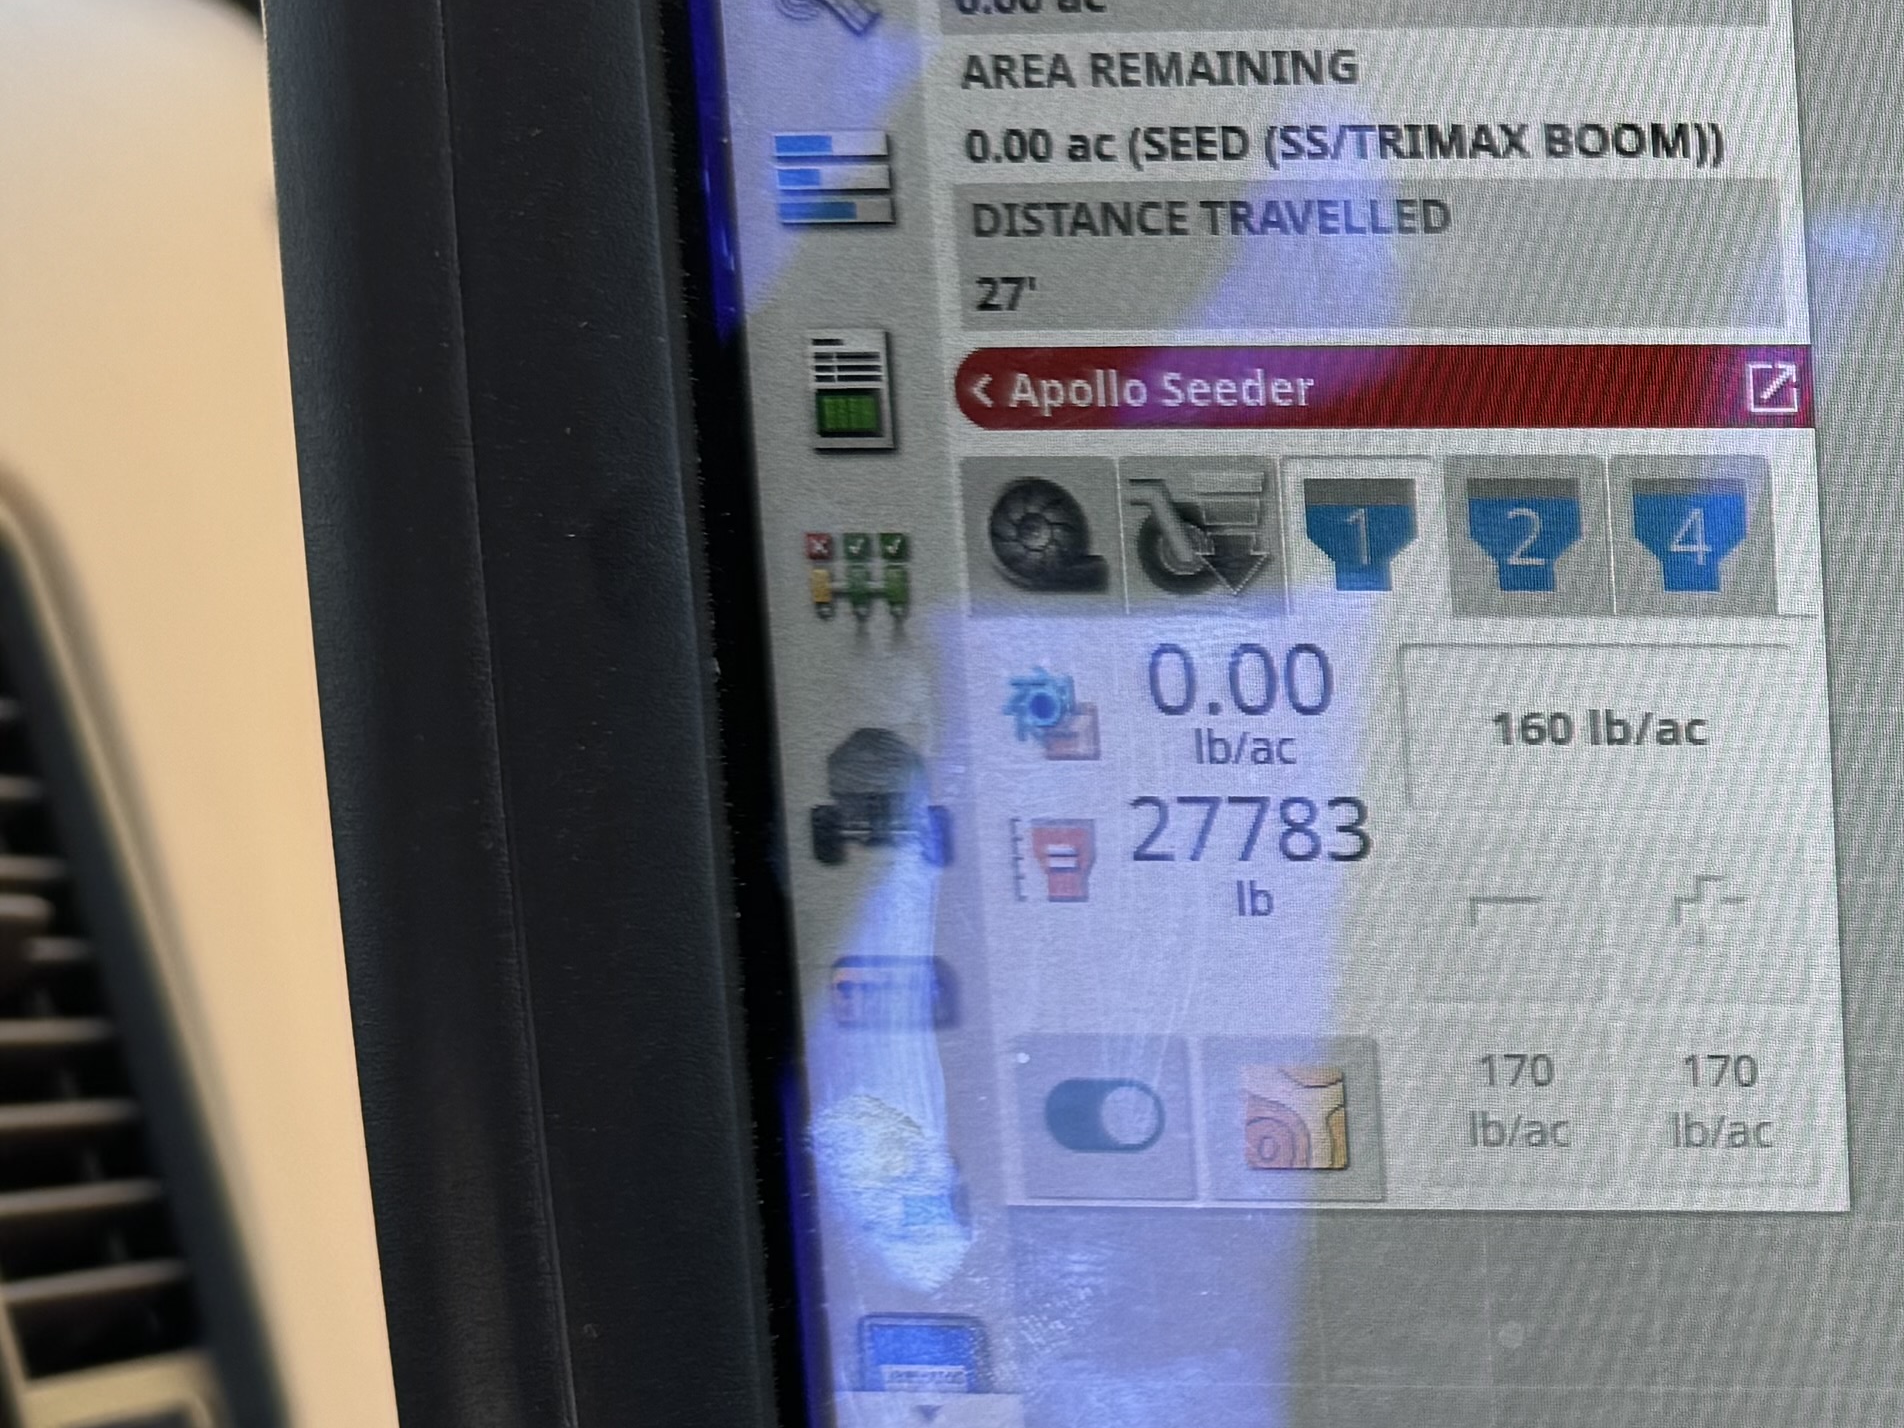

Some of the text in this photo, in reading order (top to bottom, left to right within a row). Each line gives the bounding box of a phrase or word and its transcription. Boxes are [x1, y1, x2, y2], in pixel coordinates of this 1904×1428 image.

[961, 50, 1358, 89] AREA REMAINING
[965, 121, 1723, 168] 0.00 ac (SEED (SS/TRIMAX BOOM))
[973, 199, 1451, 238] DISTANCE TRAVELLED
[976, 276, 1036, 313] 27'
[1010, 371, 1313, 418] Apollo Seeder
[1344, 510, 1371, 562] 1
[1507, 509, 1546, 566] 2
[1669, 509, 1710, 564] 4
[1147, 643, 1333, 717] 0.00
[1195, 728, 1296, 767] lb/ac
[1493, 708, 1708, 748] 160 lb/ac
[1130, 796, 1372, 864] 27783
[1237, 881, 1272, 918] lb
[1479, 1054, 1554, 1089] 170
[1685, 1054, 1758, 1089] 170
[1471, 1114, 1571, 1151] lb/ac
[1673, 1114, 1772, 1151] lb/ac
